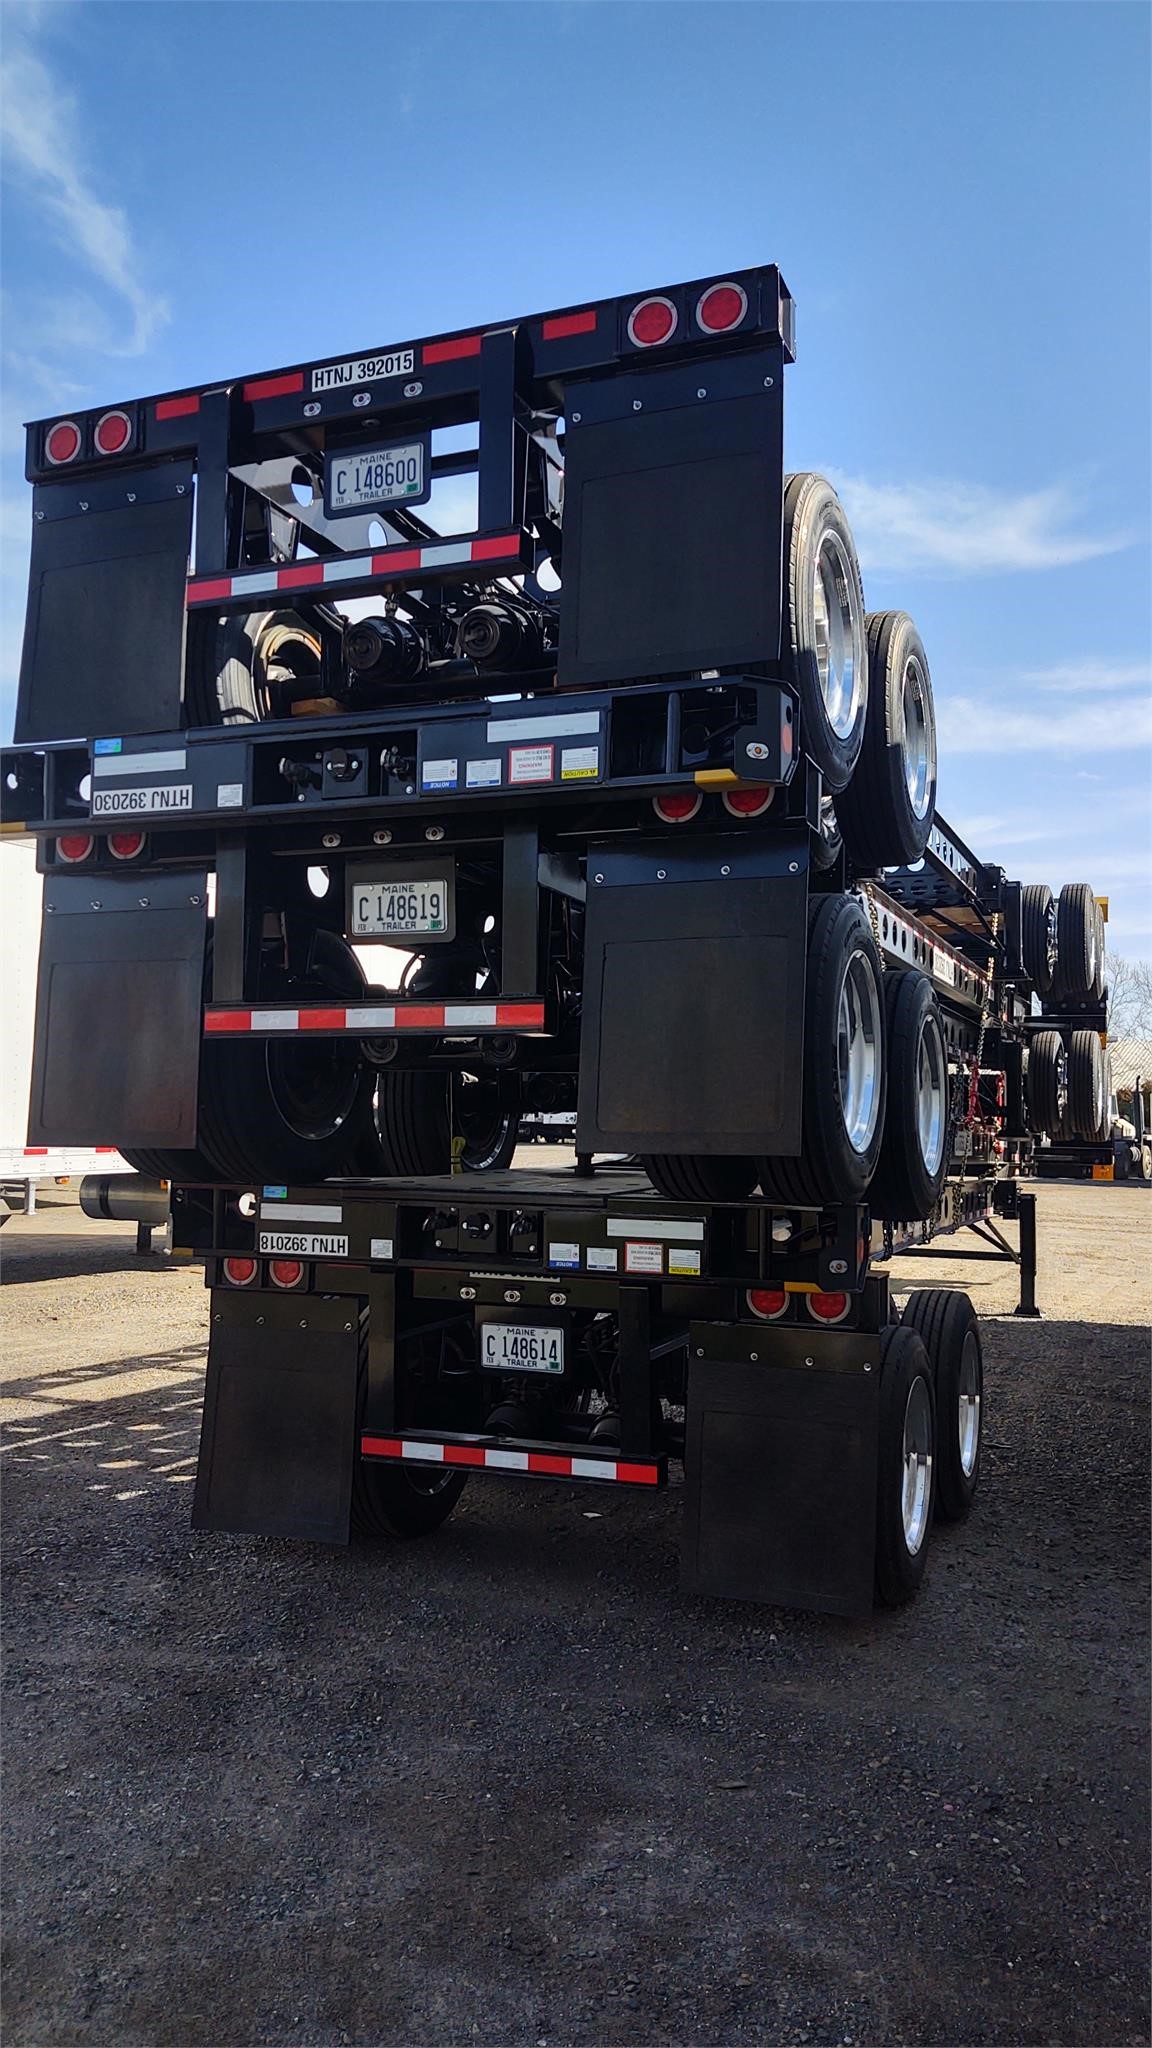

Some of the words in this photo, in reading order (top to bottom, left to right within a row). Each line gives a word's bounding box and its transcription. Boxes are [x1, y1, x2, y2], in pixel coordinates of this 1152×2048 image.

[314, 364, 353, 388] HTNJ
[357, 352, 412, 380] 392015
[360, 452, 392, 465] MAINE
[337, 470, 347, 495] C
[354, 457, 417, 493] 148600
[359, 487, 393, 501] TRAILER
[94, 791, 147, 812] 392030
[151, 789, 190, 809] HTNJ
[381, 884, 416, 894] MAINE
[359, 896, 369, 922] C
[376, 893, 440, 922] 148619
[381, 921, 417, 931] TRAILER
[260, 1235, 308, 1252] 392018
[311, 1237, 346, 1254] HTNJ
[506, 1327, 537, 1337] MAINE
[486, 1334, 496, 1357] C
[502, 1335, 558, 1362] 148614
[506, 1358, 538, 1368] TRAILER
